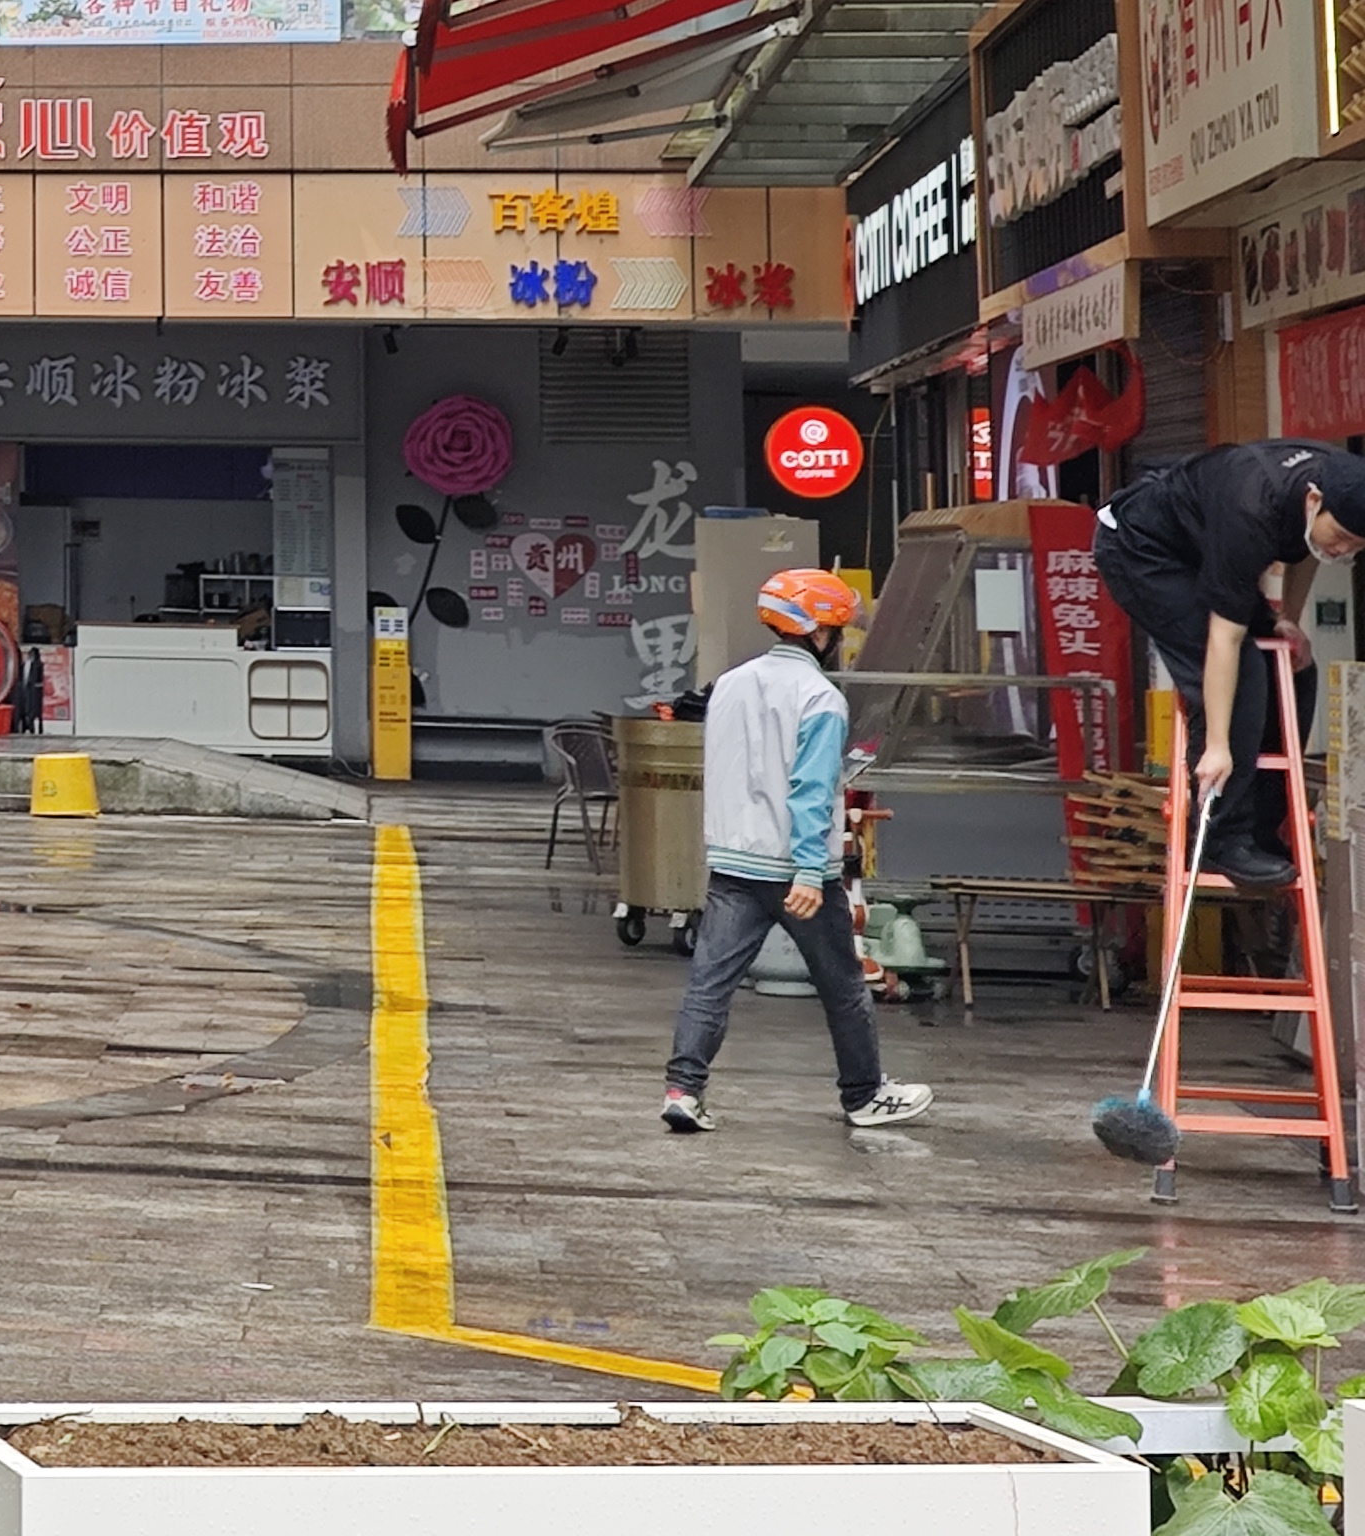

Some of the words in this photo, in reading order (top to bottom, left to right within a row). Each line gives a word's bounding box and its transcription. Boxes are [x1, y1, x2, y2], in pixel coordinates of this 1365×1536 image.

[1208, 109, 1237, 162] ZHOU
[1238, 98, 1255, 144] YA
[1256, 83, 1281, 133] TOU
[67, 181, 132, 215] 文明
[194, 181, 263, 215] 和谐
[67, 223, 132, 257] 公正
[194, 223, 263, 257] 法治
[855, 203, 891, 306] COTTI
[892, 161, 949, 284] COFFEE
[67, 265, 132, 299] 诚信
[194, 265, 263, 299] 友善
[322, 257, 407, 306] 安顺
[510, 260, 598, 310] 冰粉
[780, 449, 849, 468] COTTI
[794, 469, 836, 479] COFFEE
[525, 542, 585, 575] 贵州
[1046, 549, 1101, 657] 麻辣兔头
